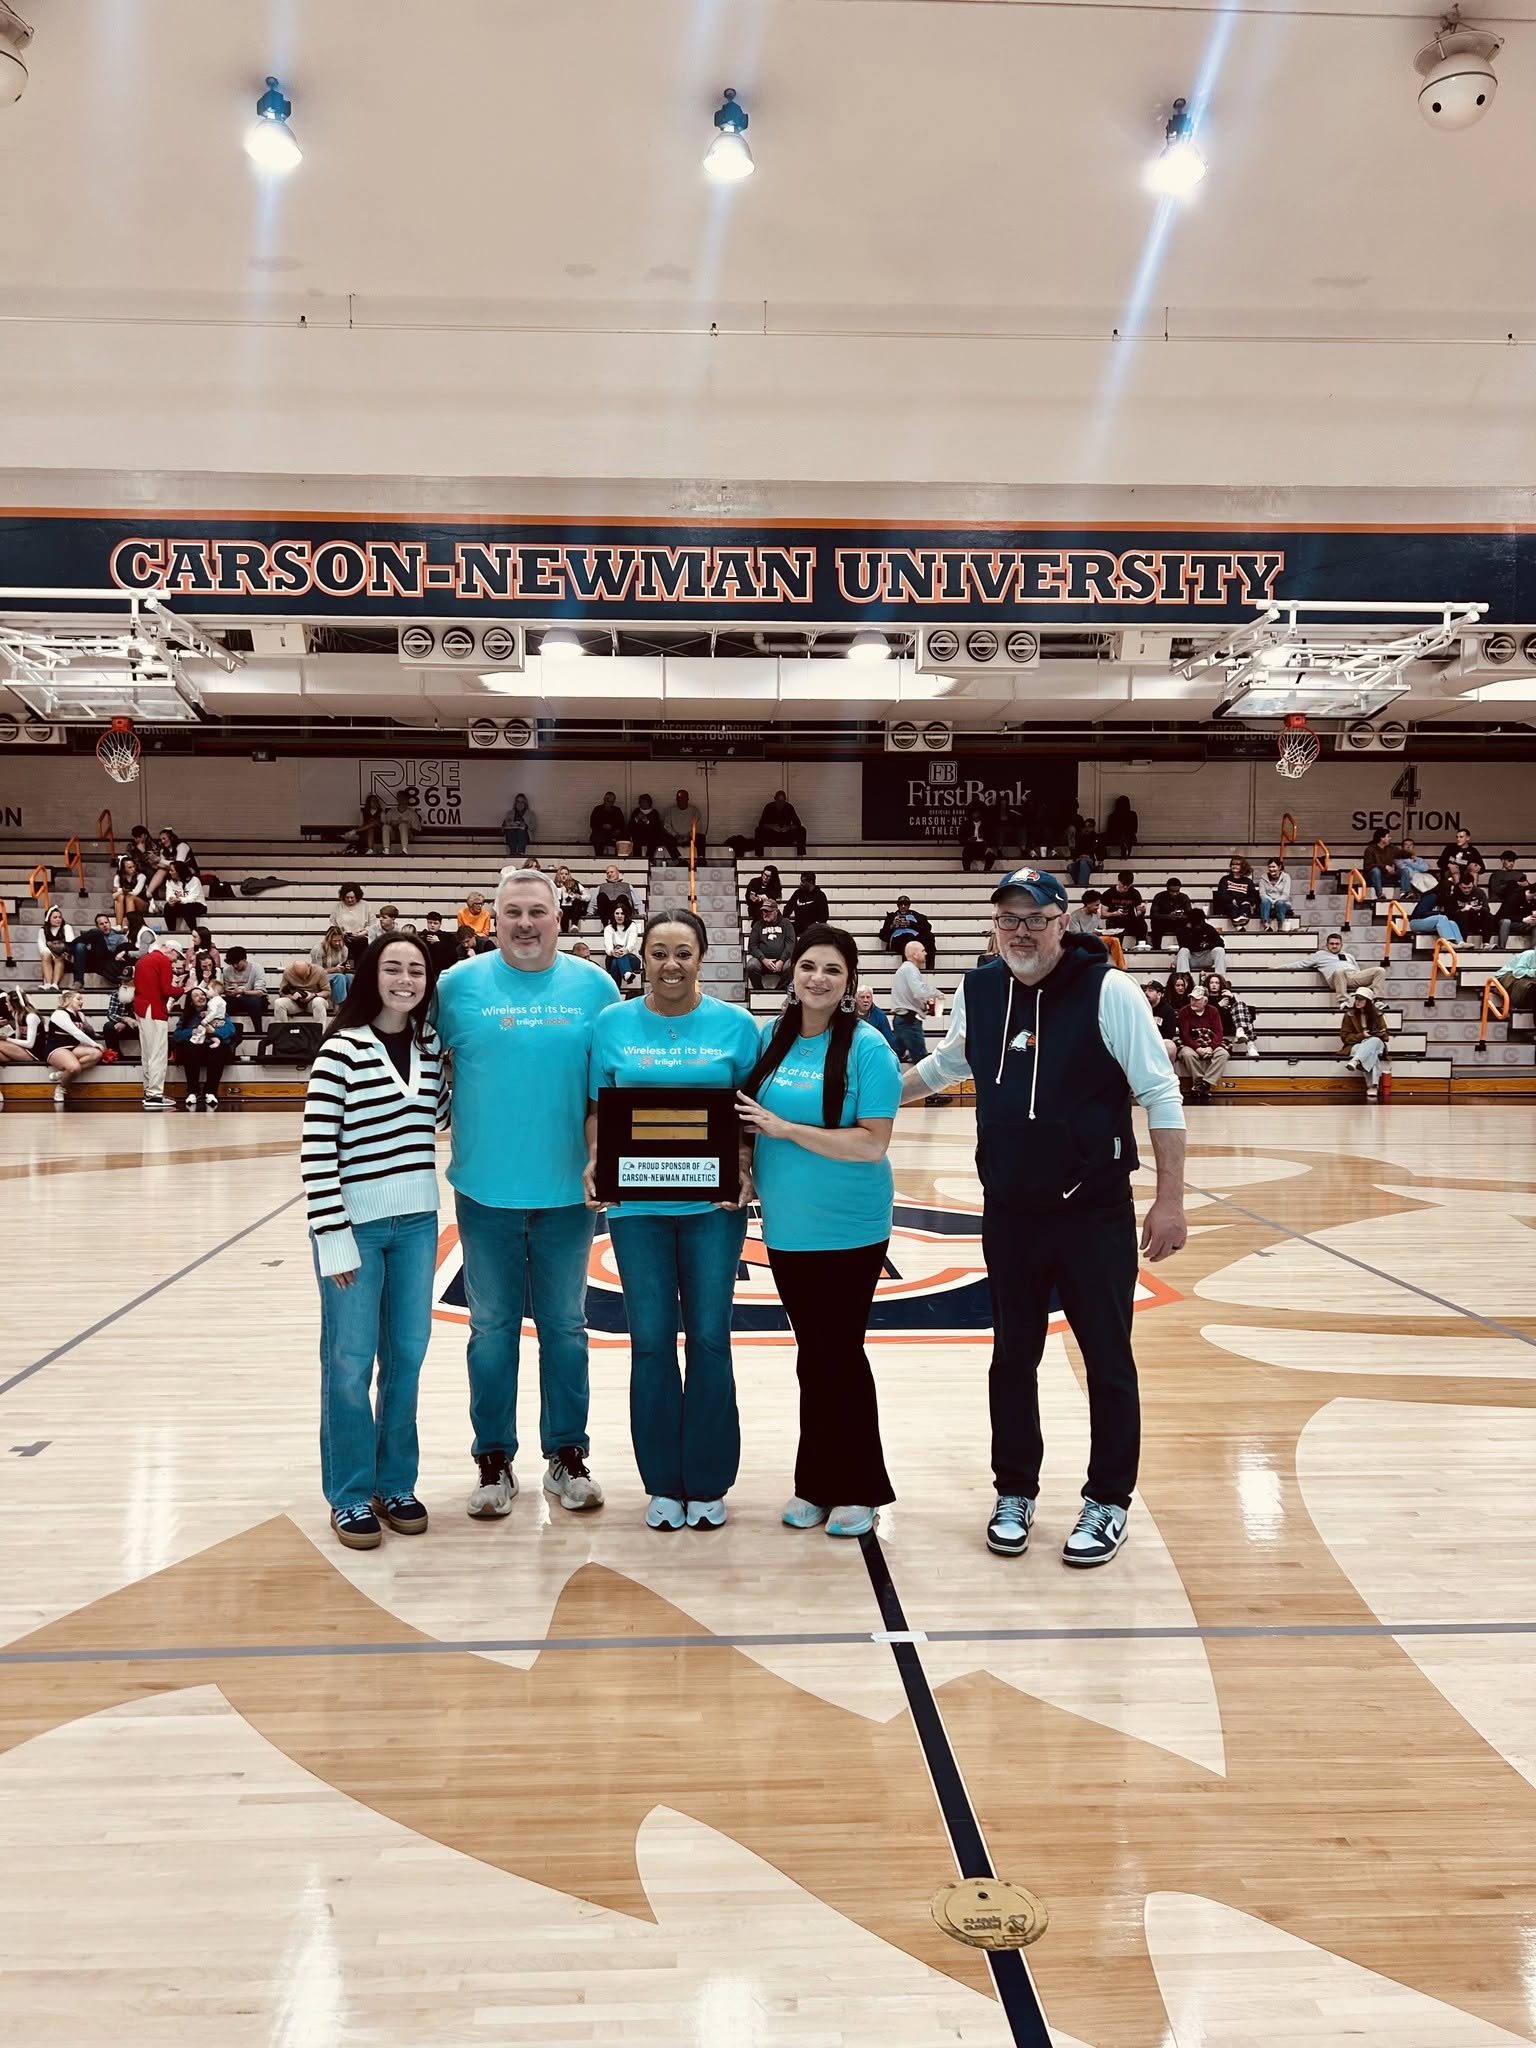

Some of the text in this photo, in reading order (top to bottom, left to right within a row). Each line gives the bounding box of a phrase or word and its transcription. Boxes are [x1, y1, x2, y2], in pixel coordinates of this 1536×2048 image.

[110, 537, 1285, 604] CARSON-NEWMAN UNIVERSITY
[360, 760, 460, 806] RISE
[1391, 765, 1421, 807] 4
[404, 787, 462, 807] 865
[907, 780, 1032, 806] FirstBank
[909, 816, 968, 826] CARSON-NE
[1352, 811, 1460, 830] SECTION
[925, 826, 960, 836] ATHLET
[482, 1004, 527, 1016] Wireless
[529, 1005, 542, 1014] at
[545, 1004, 558, 1014] its
[516, 1018, 543, 1028] trilight
[624, 1046, 667, 1056] Wireless
[669, 1047, 682, 1055] at
[684, 1046, 697, 1055] its
[654, 1058, 682, 1068] trilight
[788, 1068, 799, 1077] at
[638, 1162, 700, 1170] PROUD SPONSOR OF
[622, 1173, 716, 1182] CARSON-NEWMAN ATHLETICS
